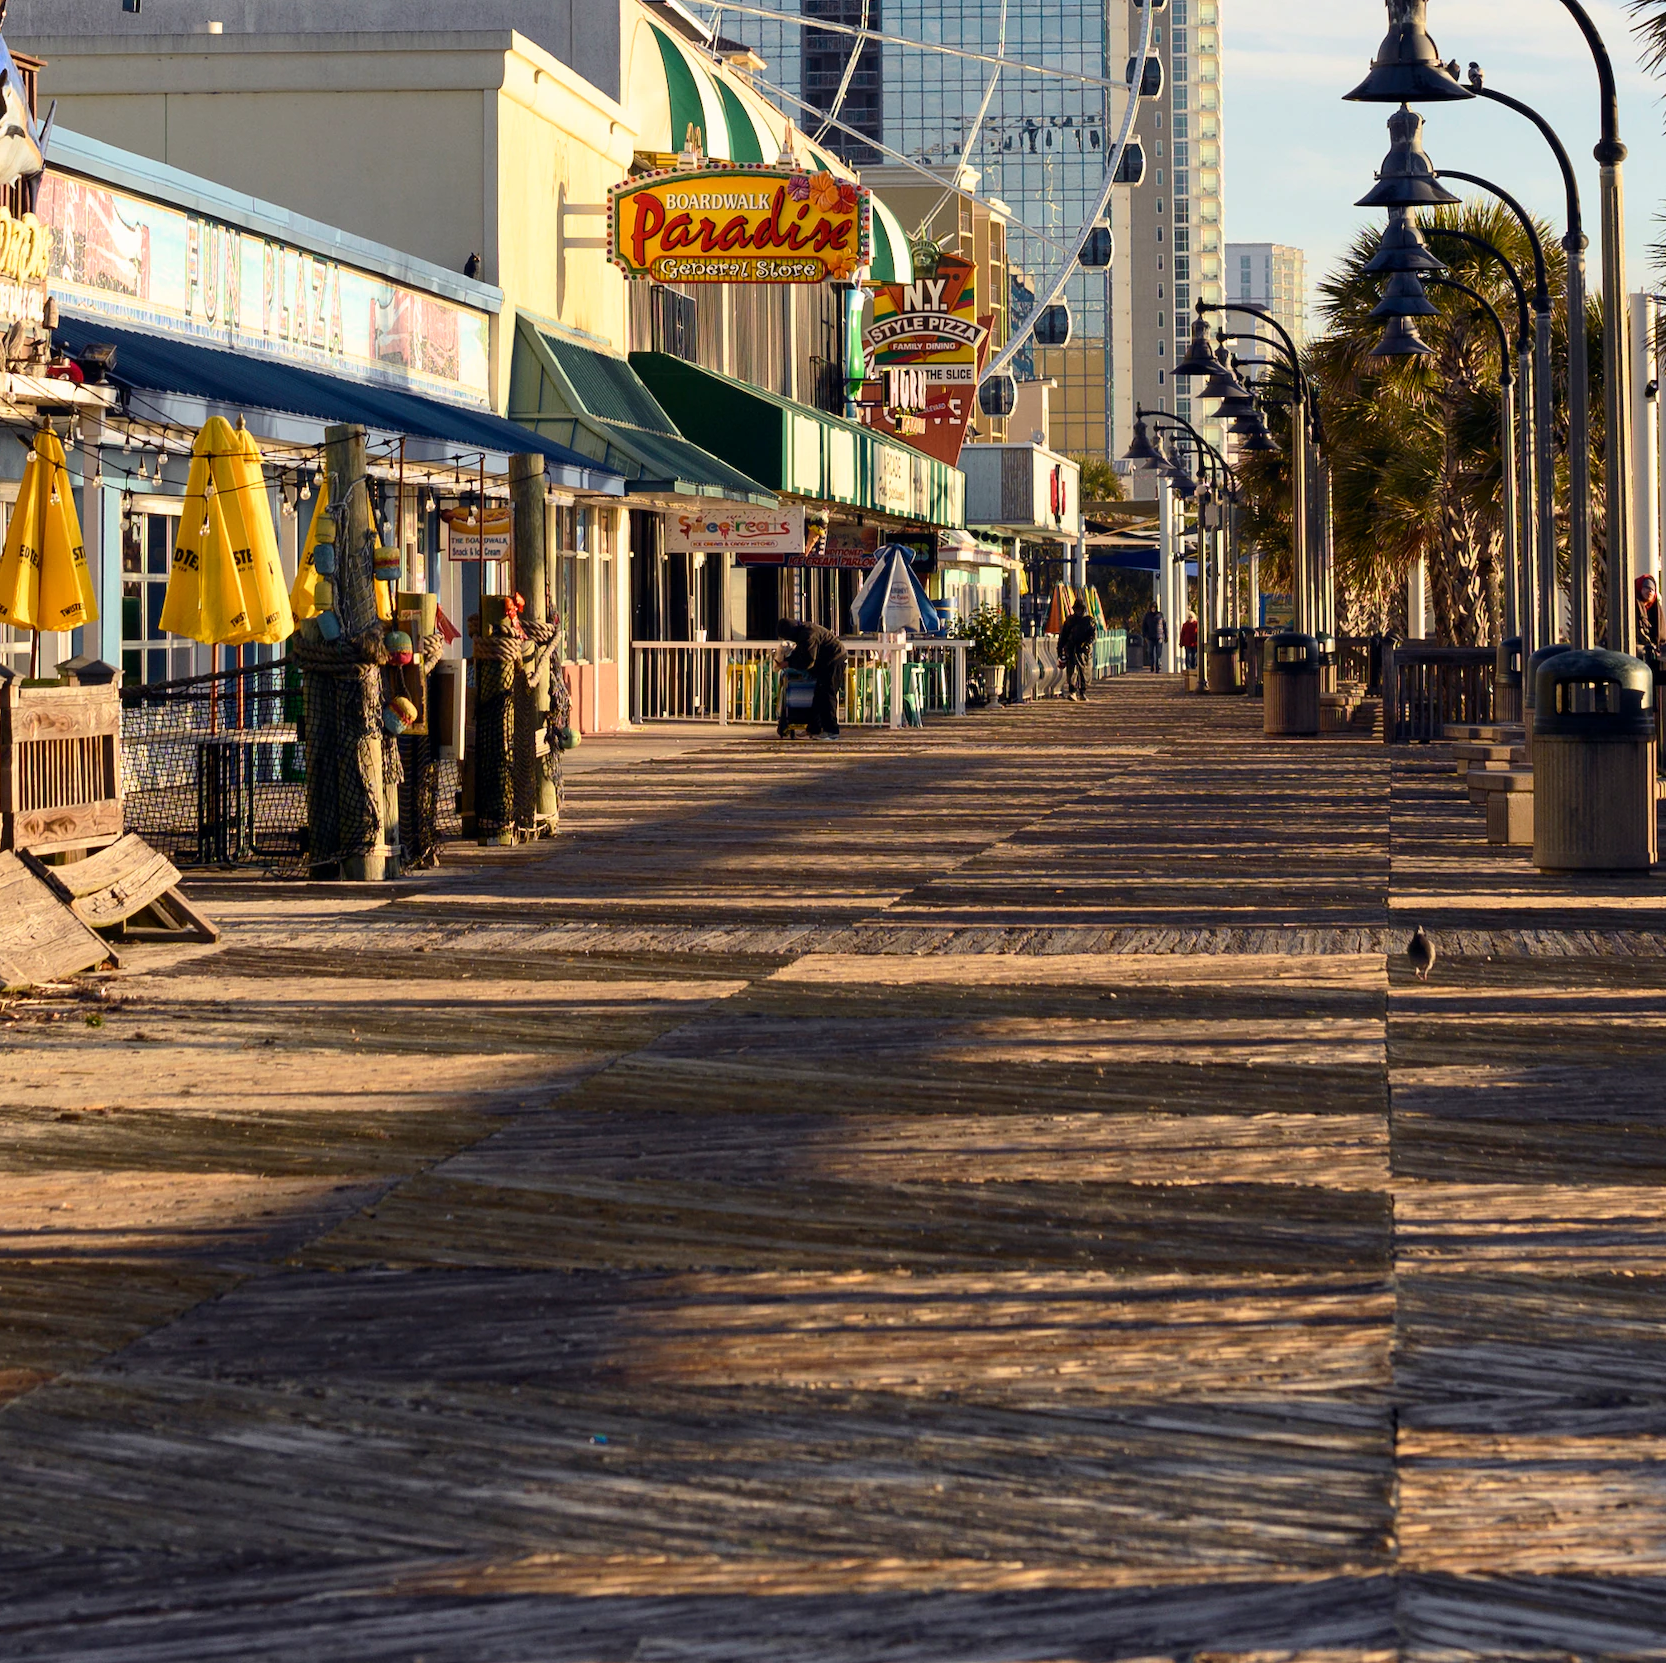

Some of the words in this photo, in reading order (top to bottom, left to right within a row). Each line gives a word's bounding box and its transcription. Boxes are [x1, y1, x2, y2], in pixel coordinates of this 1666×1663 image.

[666, 193, 771, 210] BOARDWALK
[631, 186, 853, 266] Paradise
[660, 258, 748, 278] General
[756, 260, 816, 278] Store
[185, 213, 242, 330] FUN
[263, 238, 344, 355] PLAZA
[904, 279, 948, 312] N.Y.
[870, 317, 925, 343] STYLE
[928, 317, 977, 342] PIZZA
[892, 342, 923, 350] FAMILY
[925, 342, 956, 350] DINING
[946, 369, 972, 380] SLICE
[465, 537, 508, 545] BOADWALK
[453, 547, 467, 556] Snack
[484, 547, 501, 556] Cream
[788, 556, 803, 566] ICE
[805, 556, 839, 566] CREAM
[840, 556, 877, 567] PARLOR
